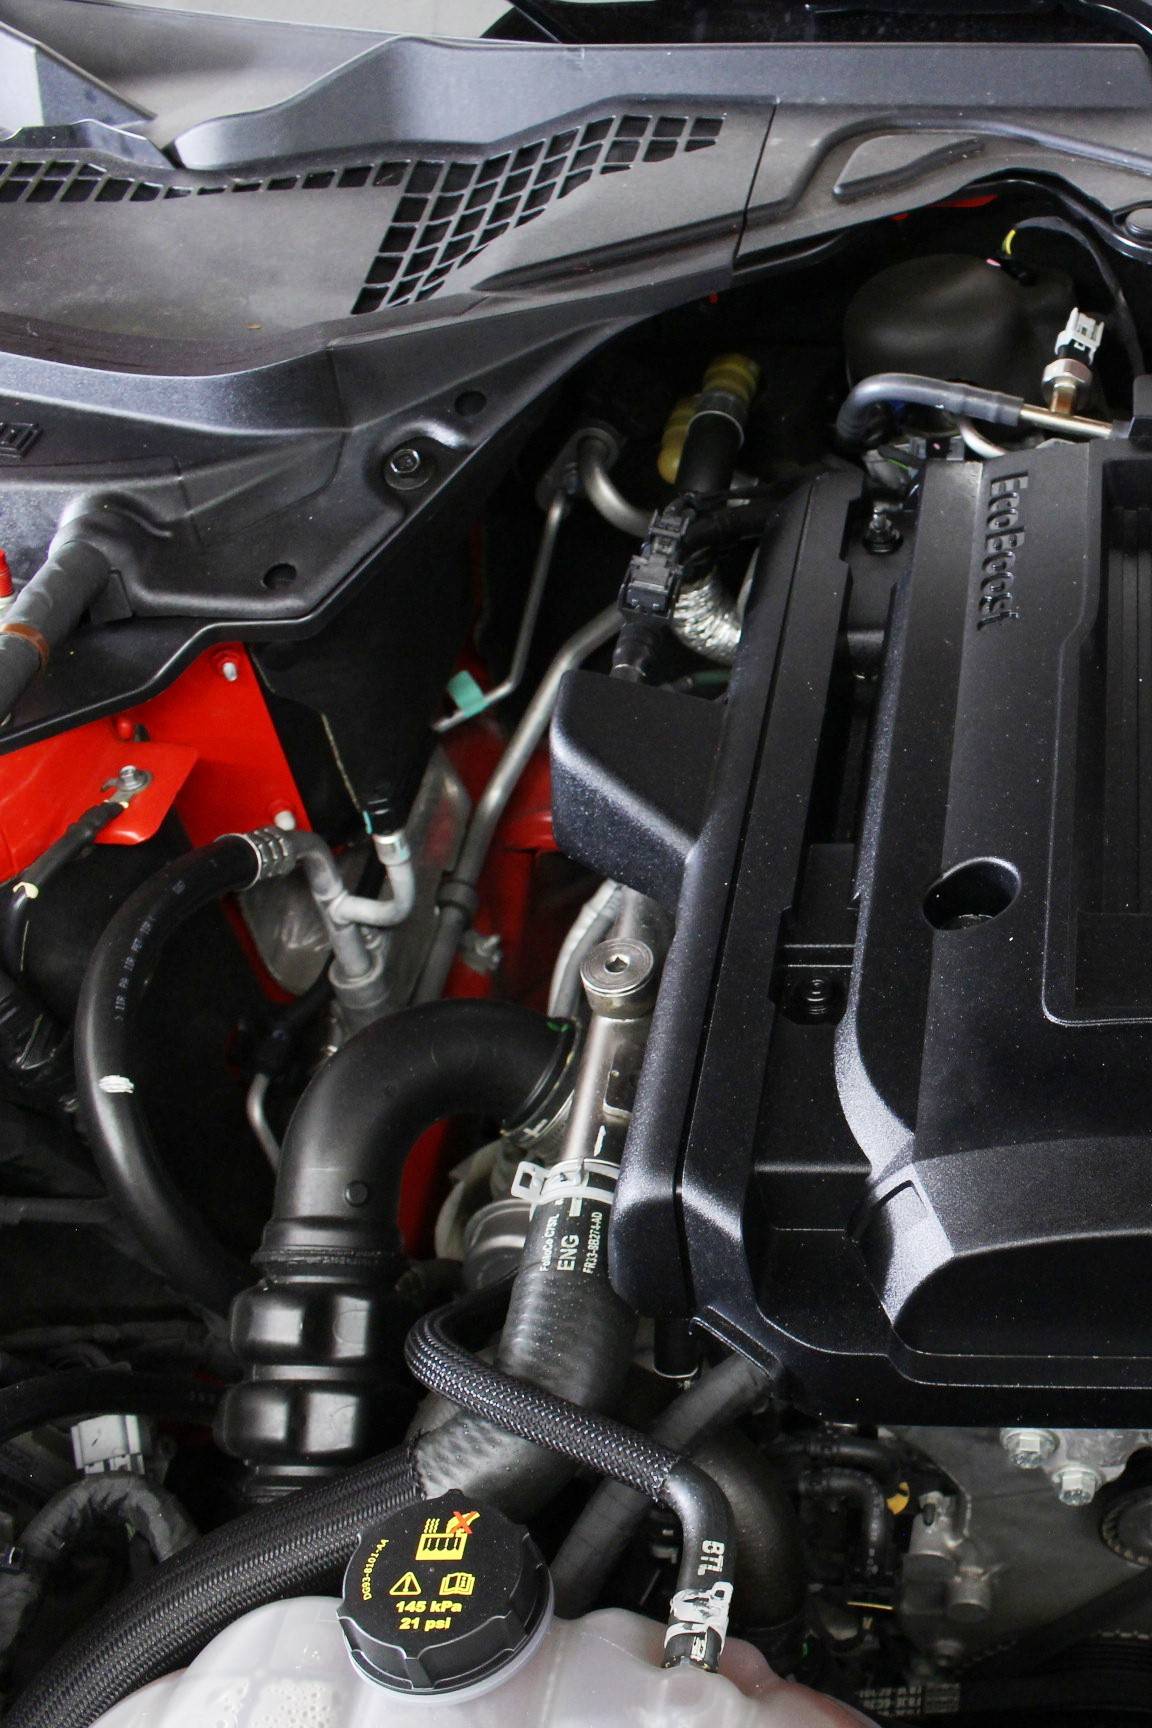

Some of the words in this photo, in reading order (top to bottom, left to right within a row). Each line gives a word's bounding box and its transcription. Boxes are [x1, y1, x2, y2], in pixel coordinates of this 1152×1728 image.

[977, 470, 1029, 631] EcoBoost
[556, 1234, 580, 1271] ENG
[362, 1538, 390, 1601] DG93-8101-AA
[697, 1539, 726, 1576] BTL
[395, 1600, 426, 1613] 145
[429, 1600, 462, 1613] kPa
[398, 1617, 420, 1630] 21
[424, 1617, 451, 1632] psi
